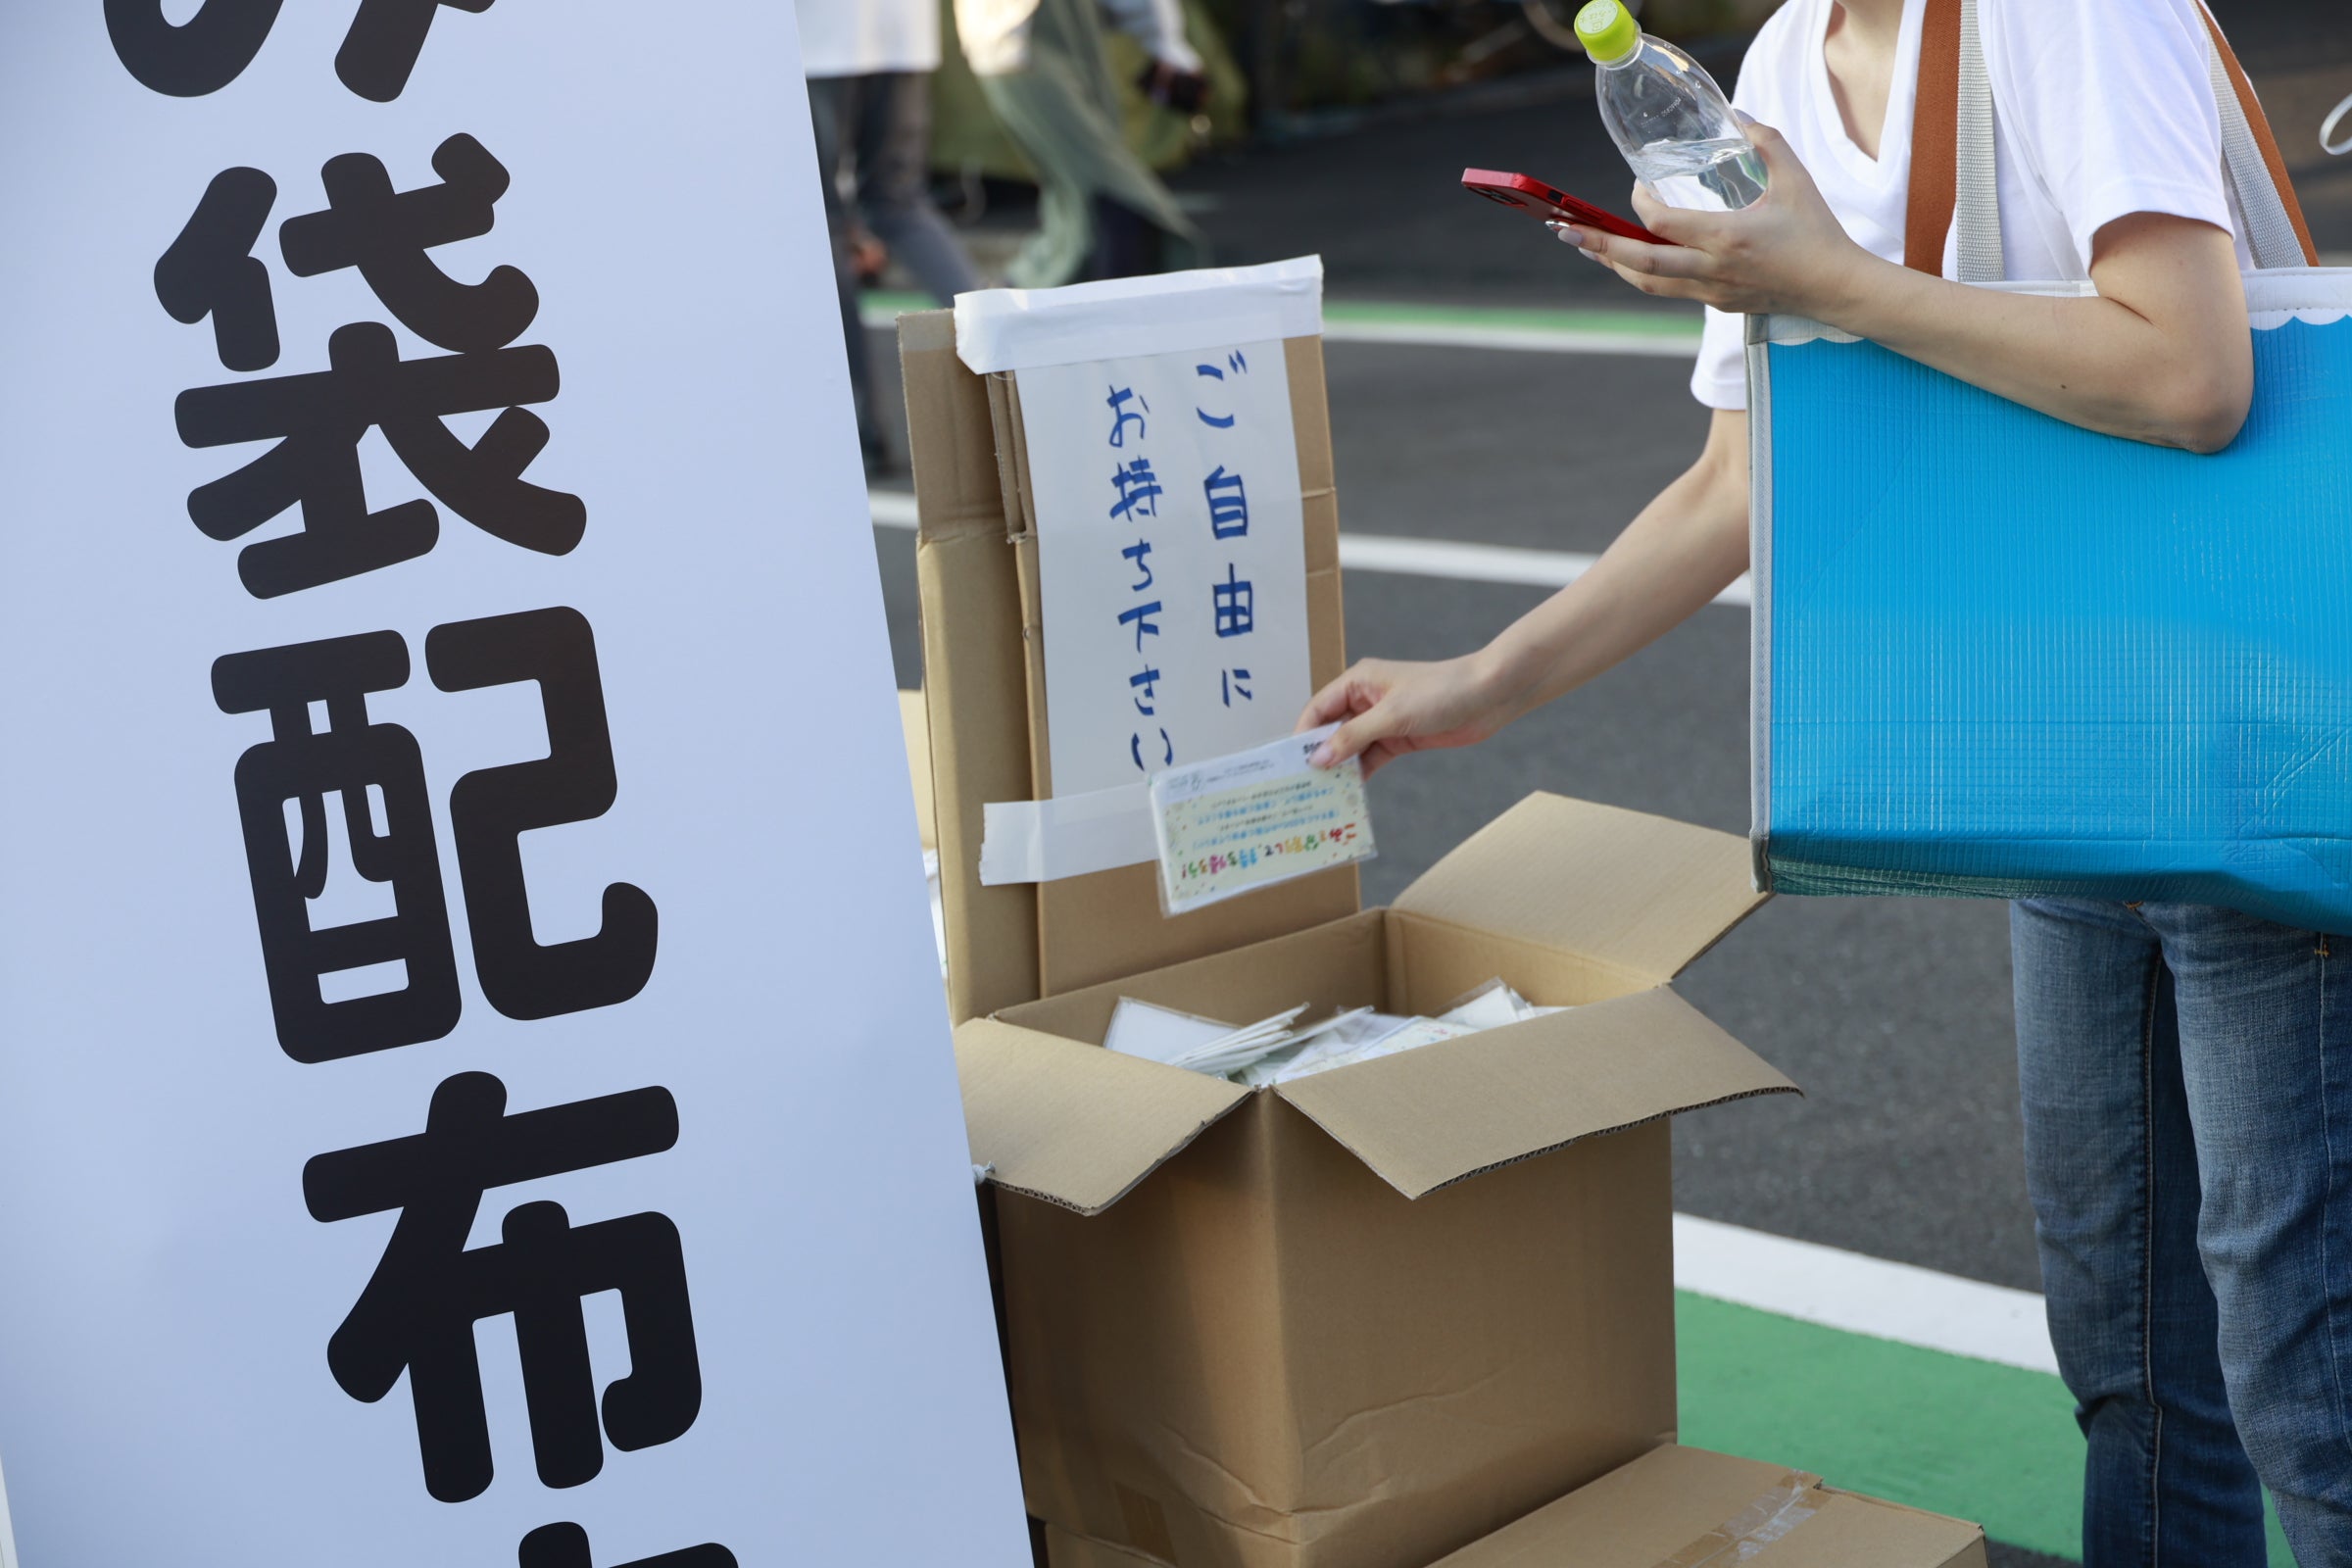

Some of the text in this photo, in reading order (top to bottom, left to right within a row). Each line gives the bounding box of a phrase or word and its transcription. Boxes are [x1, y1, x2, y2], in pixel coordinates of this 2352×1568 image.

[1108, 384, 1174, 772] お持ち下さい
[1196, 349, 1253, 708] ご自由に
[103, 0, 740, 1568] 袋配布
